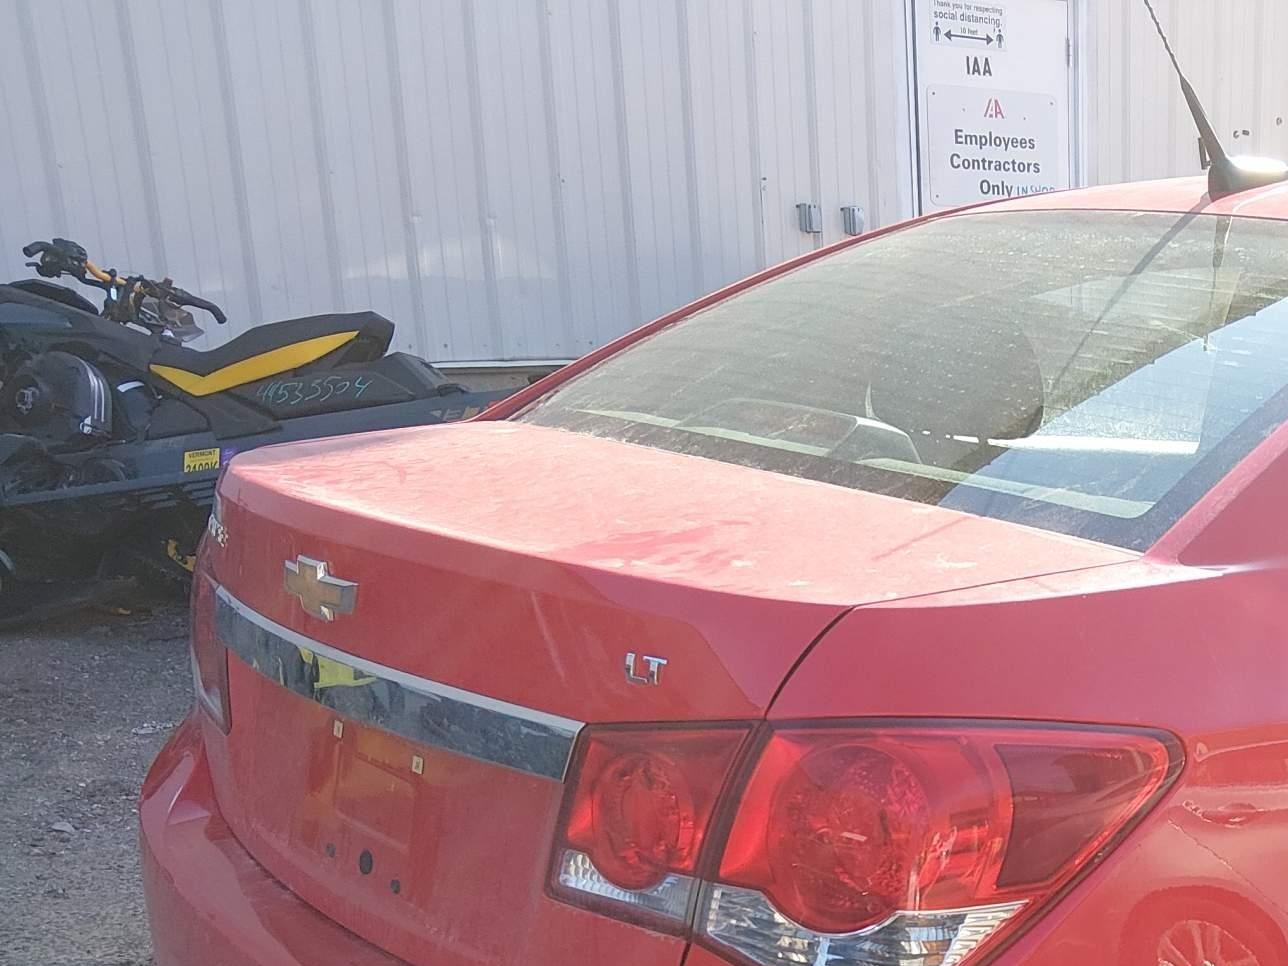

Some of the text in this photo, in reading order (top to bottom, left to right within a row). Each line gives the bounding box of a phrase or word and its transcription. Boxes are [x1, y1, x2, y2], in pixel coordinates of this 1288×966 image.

[933, 10, 958, 21] social
[952, 3, 963, 11] you
[964, 3, 972, 11] for
[974, 5, 1003, 17] respecting
[966, 55, 993, 77] IAA
[954, 128, 1036, 152] Employees
[949, 153, 1041, 174] Contractors
[979, 178, 1013, 198] Only
[625, 652, 668, 686] LT
